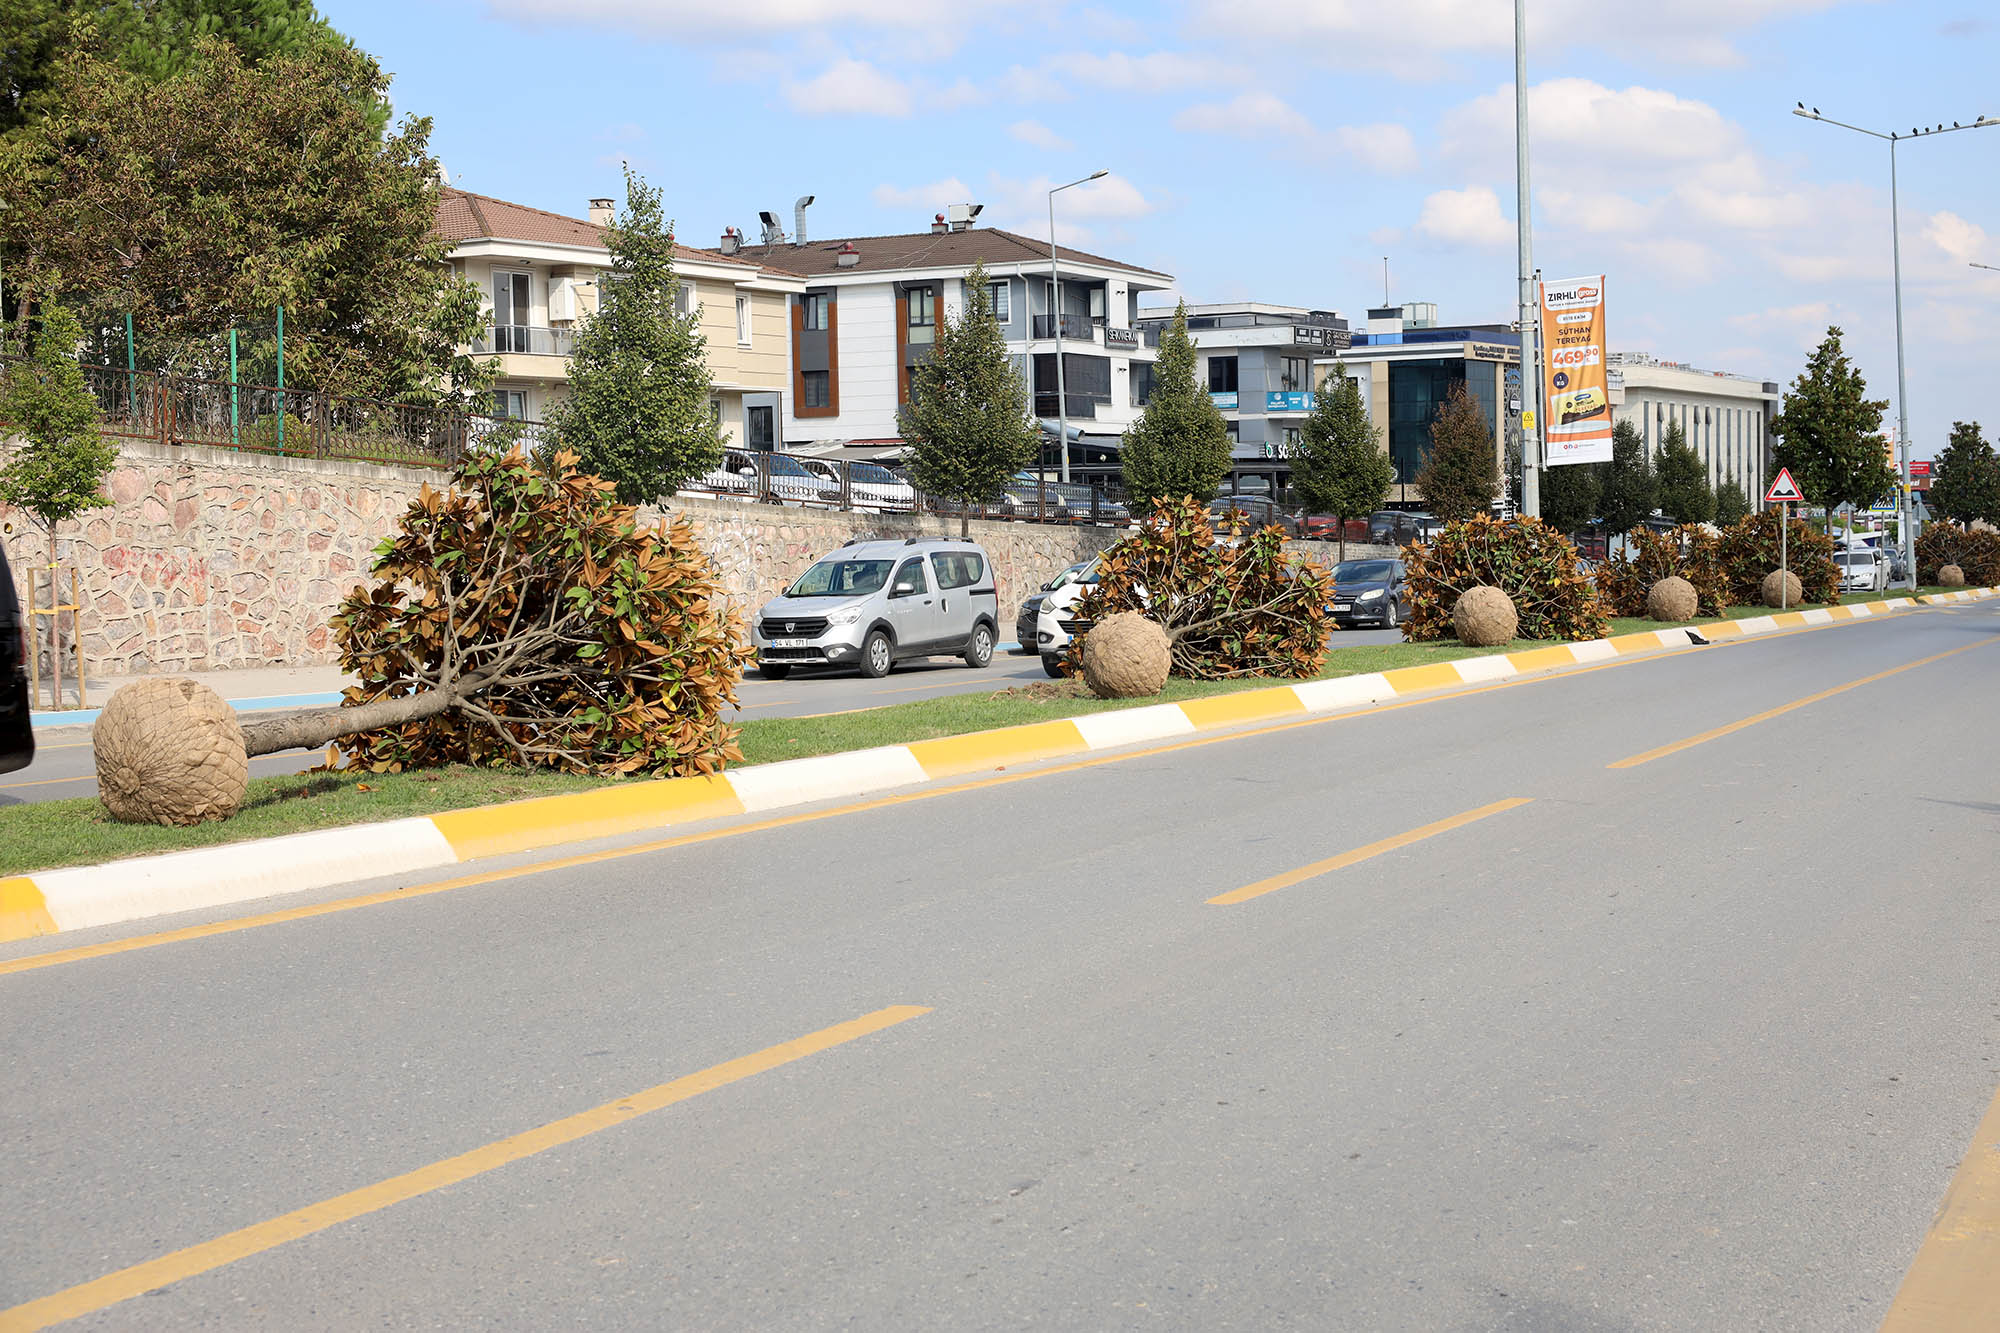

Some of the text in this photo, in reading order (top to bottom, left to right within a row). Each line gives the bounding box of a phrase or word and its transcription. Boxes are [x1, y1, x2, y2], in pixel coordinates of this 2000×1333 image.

[1547, 290, 1577, 302] ZIRHLI
[1558, 326, 1592, 336] SÜTHAN
[1556, 336, 1592, 345] TEREYAĞ
